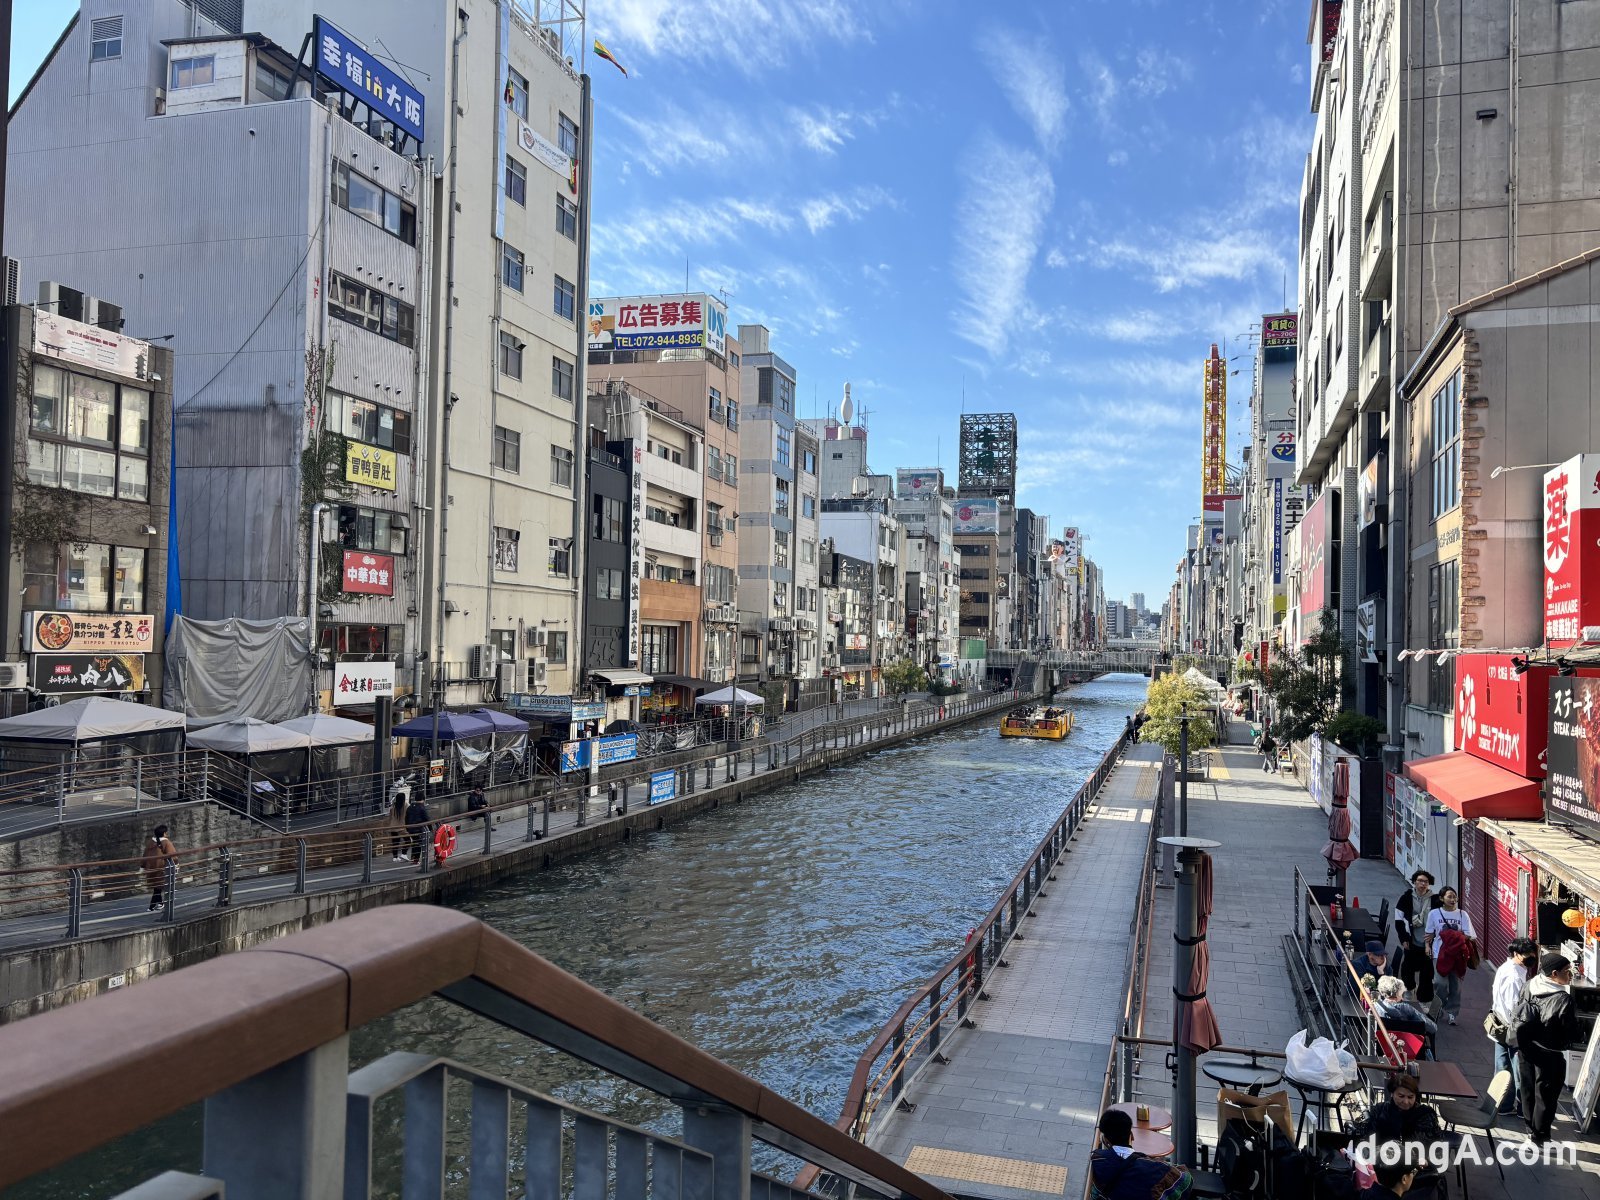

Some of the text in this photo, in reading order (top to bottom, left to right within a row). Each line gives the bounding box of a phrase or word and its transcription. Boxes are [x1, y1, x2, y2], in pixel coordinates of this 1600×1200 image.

[322, 35, 420, 127] 幸福in大阪
[618, 300, 702, 328] 広告募集
[708, 302, 724, 338] DS
[616, 334, 702, 347] TEL:072-944-8936
[347, 566, 389, 586] 中華食堂
[1555, 598, 1578, 616] AKAKABE
[1554, 688, 1593, 722] ステーキ
[1554, 721, 1570, 736] STEAK
[1491, 726, 1520, 762] アカカベ
